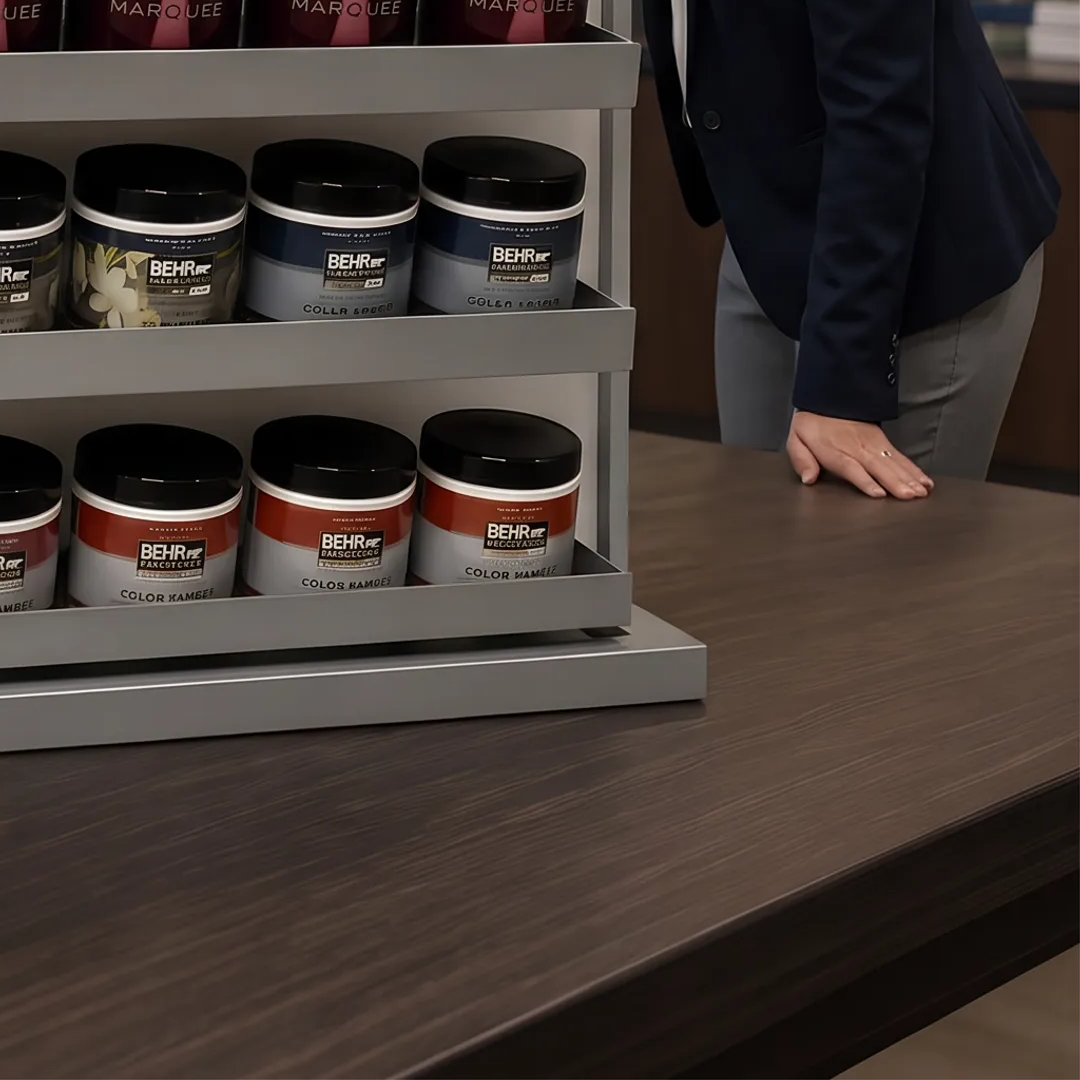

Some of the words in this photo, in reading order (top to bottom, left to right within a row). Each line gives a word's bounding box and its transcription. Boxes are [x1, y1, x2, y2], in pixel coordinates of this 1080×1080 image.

[328, 253, 371, 269] BEHR
[492, 246, 535, 263] BEHR
[150, 260, 195, 277] BEHR
[487, 523, 531, 540] BEHR
[321, 533, 366, 550] BEHR
[140, 543, 186, 560] BEHR
[465, 566, 510, 580] COLOR
[120, 589, 165, 603] COLOR
